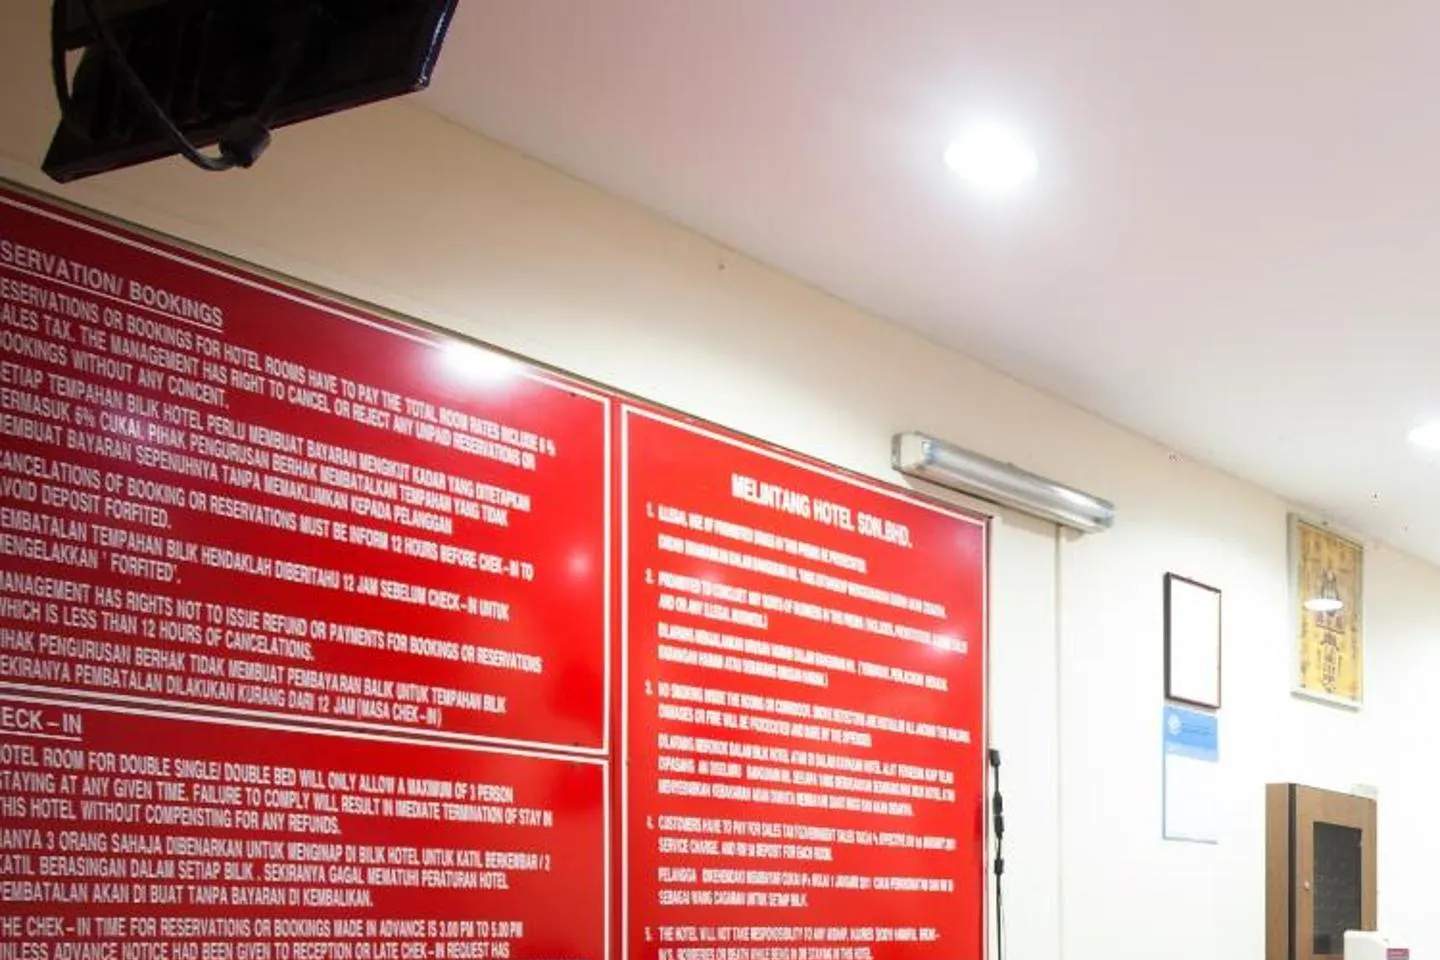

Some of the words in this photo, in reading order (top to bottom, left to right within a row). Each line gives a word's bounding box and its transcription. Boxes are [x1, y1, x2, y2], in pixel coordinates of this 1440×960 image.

[129, 281, 222, 326] BOOKINGS
[71, 349, 132, 383] WITHOUT
[138, 367, 163, 390] ANY
[80, 326, 106, 350] THE
[110, 334, 198, 376] MANAGEMENT
[202, 361, 227, 384] HAS
[287, 385, 331, 413] CANCEL
[103, 307, 123, 330] OR
[126, 314, 192, 350] BOOKINGS
[195, 335, 221, 358] FOR
[307, 369, 337, 393] HAVE
[47, 373, 122, 409] TEMPAHAN
[126, 394, 159, 418] BILIK
[163, 402, 203, 430] HOTEL
[306, 440, 357, 468] BAYARAN
[66, 429, 131, 460] BAYARAN
[135, 445, 218, 480] SEPENUHNYA
[145, 423, 185, 448] PIHAK
[189, 433, 269, 468] PENGURUSAN
[41, 484, 100, 514] DEPOSIT
[104, 497, 171, 528] FORFITED.
[104, 472, 123, 493] OF
[127, 477, 185, 506] BOOKING
[188, 490, 206, 511] OR
[298, 515, 330, 538] MUST
[731, 472, 811, 519] MELINTANG
[812, 498, 855, 532] HOTEL
[91, 524, 163, 555] TEMPAHAN
[166, 539, 198, 562] BILIK
[200, 546, 272, 576] HENDAKLAH
[45, 604, 58, 623] IS
[63, 606, 97, 629] LESS
[101, 612, 137, 633] THAN
[142, 619, 155, 637] 12
[159, 620, 202, 643] HOURS
[95, 586, 122, 607] HAS
[126, 591, 173, 615] RIGHTS
[176, 599, 202, 620] NOT
[329, 623, 385, 648] PAYMENTS
[39, 634, 131, 664] PENGURUSAN
[134, 647, 185, 670] BERHAK
[189, 654, 224, 675] TIDAK
[287, 668, 362, 693] PEMBAYARAN
[74, 664, 162, 691] PEMBATALAN
[166, 676, 234, 700] DILAKUKAN
[62, 714, 81, 733] IN
[43, 748, 84, 768] ROOM
[88, 751, 115, 771] FOR
[119, 754, 171, 775] DOUBLE
[273, 767, 296, 785] BED
[30, 798, 76, 818] HOTEL
[80, 801, 140, 821] WITHOUT
[145, 805, 232, 826] COMPENSTING
[60, 775, 76, 793] AT
[82, 776, 109, 795] ANY
[113, 778, 152, 798] GIVEN
[193, 784, 242, 804] FAILURE
[341, 796, 380, 814] RESULT
[59, 831, 107, 851] ORANG
[111, 834, 162, 853] SAHAJA
[165, 837, 242, 856] DIBENARKAN
[39, 856, 126, 876] BERASINGAN
[130, 859, 174, 877] DALAM
[178, 861, 220, 879] SETIAP
[328, 866, 364, 883] GAGAL
[92, 884, 129, 901] AKAN
[133, 885, 146, 902] DI
[149, 885, 183, 902] BUAT
[187, 886, 228, 903] TANPA
[95, 918, 126, 935] TIME
[130, 918, 156, 935] FOR
[160, 918, 251, 936] RESERVATIONS
[333, 920, 363, 936] MADE
[53, 943, 117, 960] ADVANCE
[121, 943, 168, 960] NOTICE
[172, 943, 198, 959] HAD
[201, 943, 233, 959] BEEN
[292, 943, 352, 959] RECEPTION
